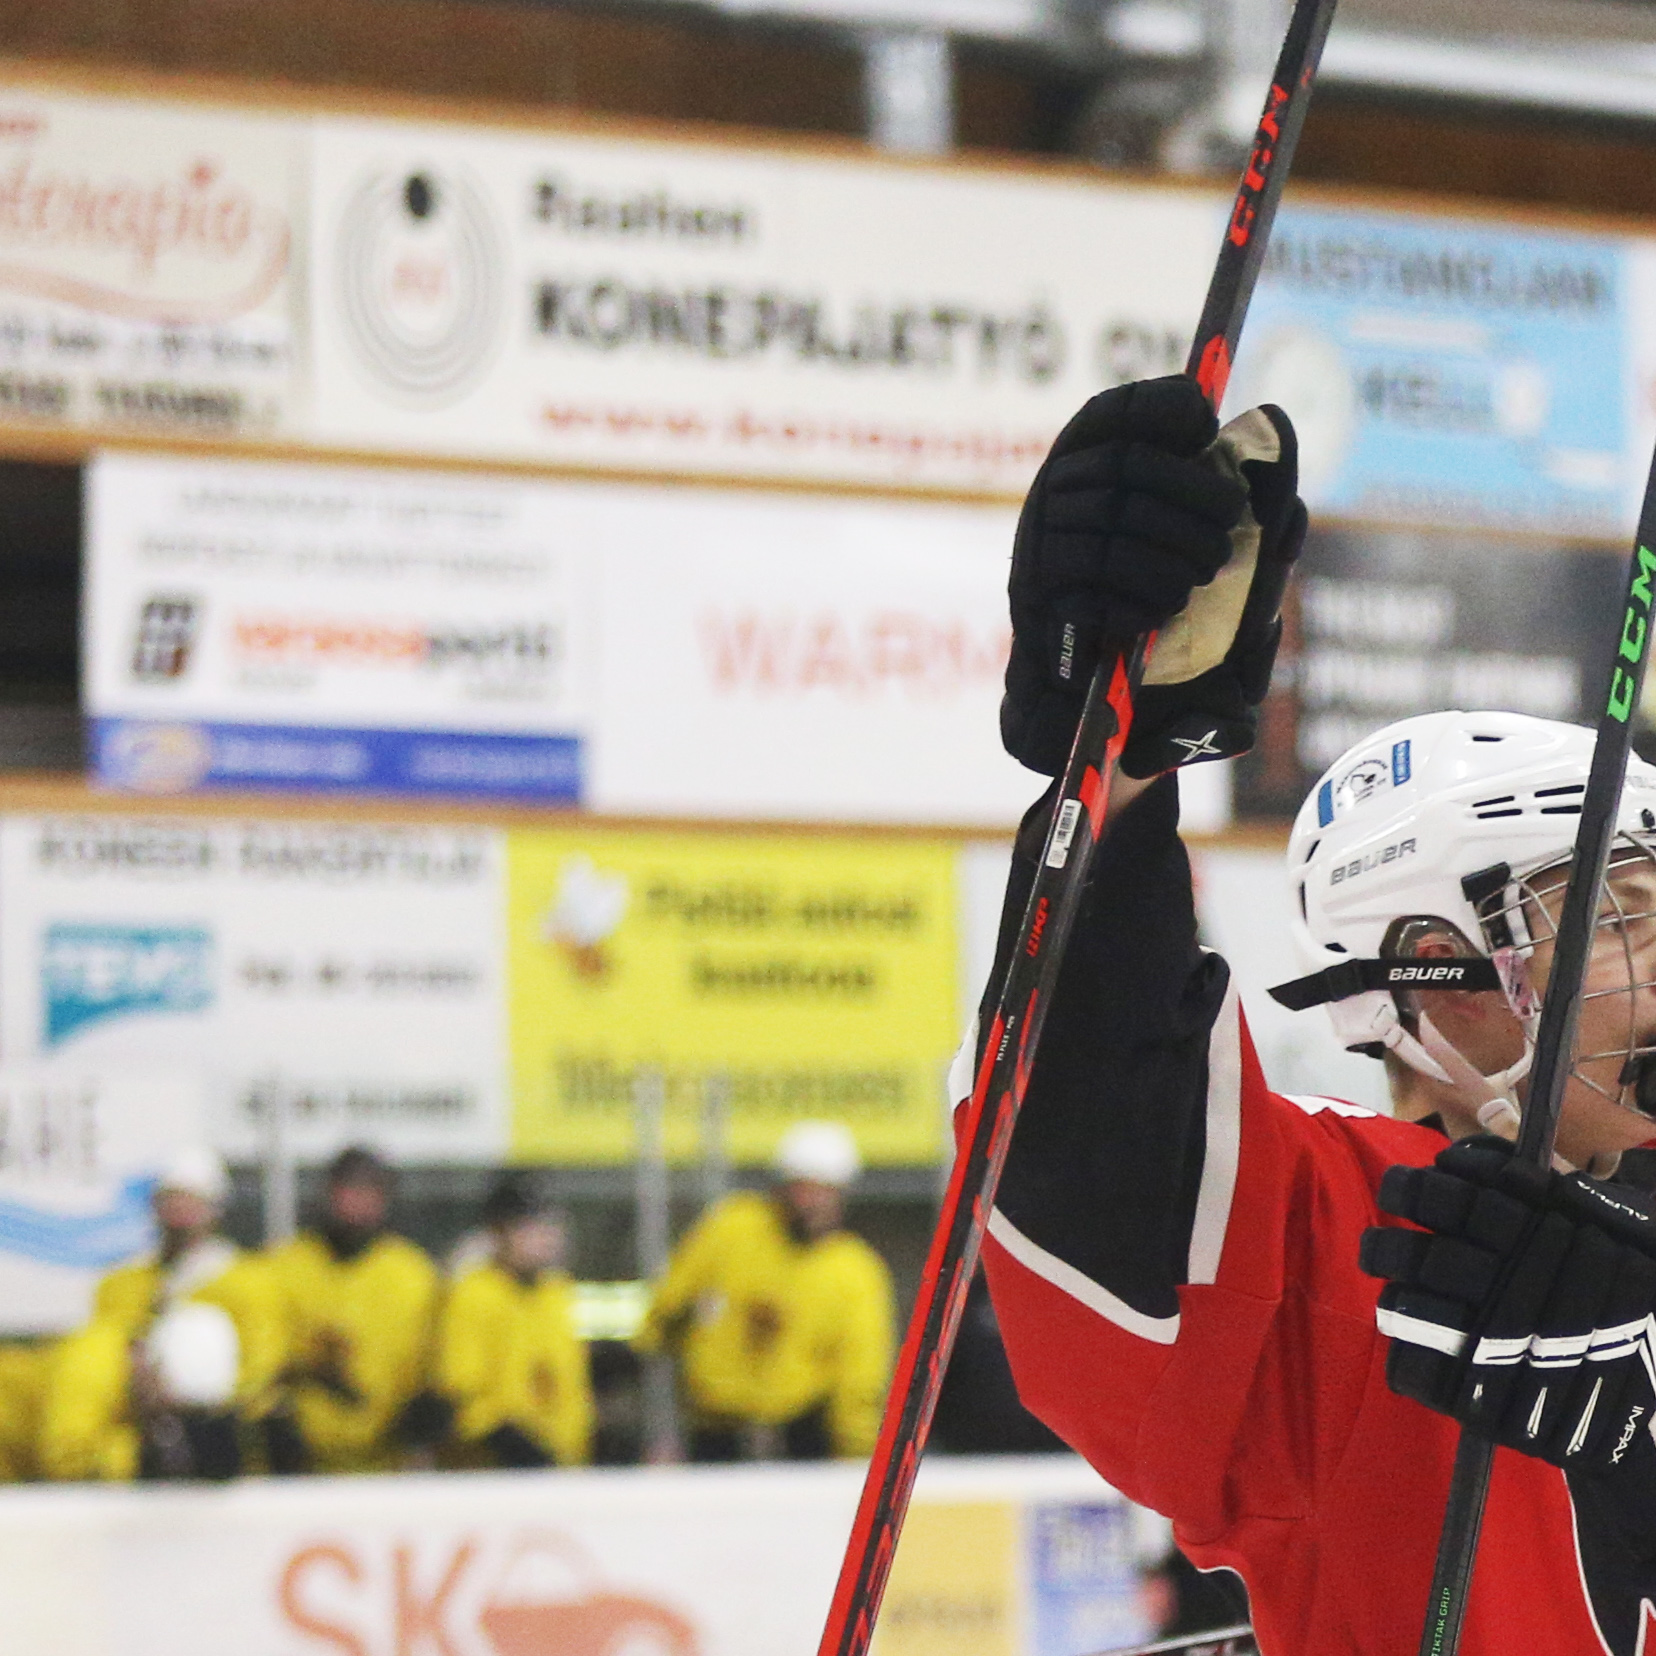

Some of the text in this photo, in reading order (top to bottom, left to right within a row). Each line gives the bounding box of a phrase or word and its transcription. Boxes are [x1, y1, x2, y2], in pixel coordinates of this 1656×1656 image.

[1329, 836, 1418, 886] BAUER
[1388, 965, 1466, 982] BAUER
[1439, 1586, 1451, 1617] GRIP
